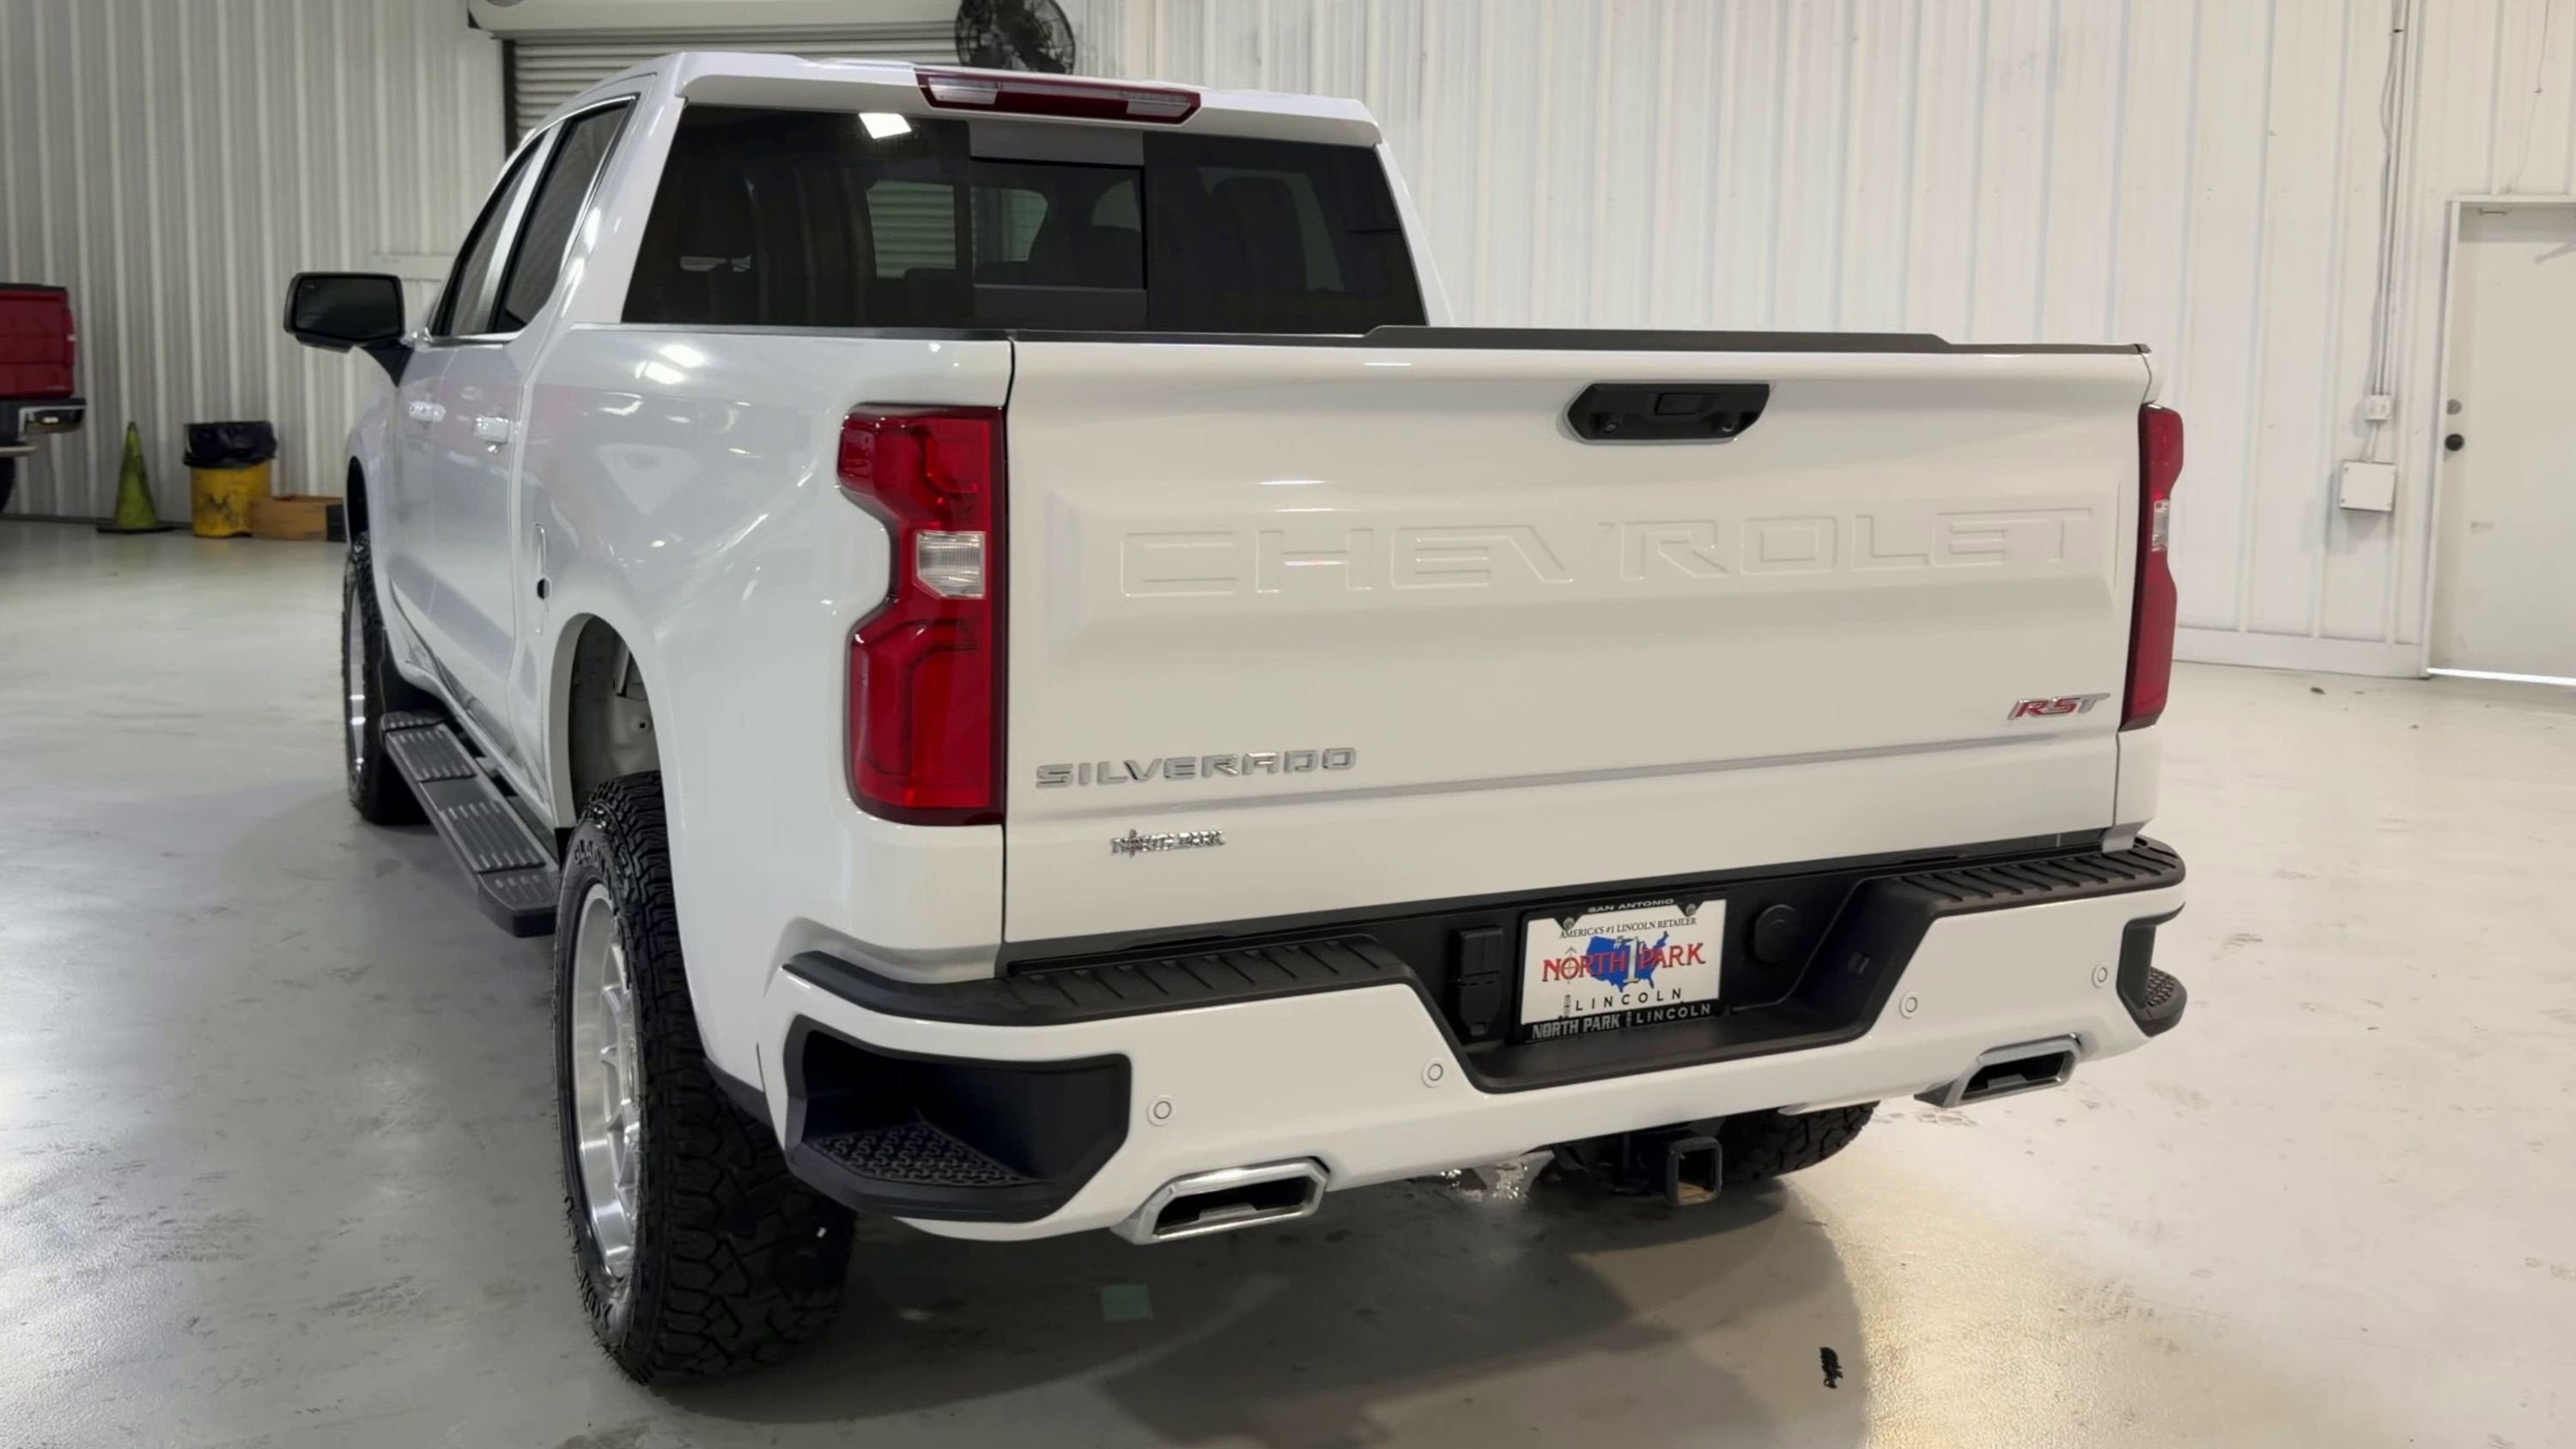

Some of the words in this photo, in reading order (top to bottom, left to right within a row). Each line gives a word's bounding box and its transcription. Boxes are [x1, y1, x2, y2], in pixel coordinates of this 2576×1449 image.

[1120, 507, 2093, 597] CHEVROLET
[2008, 692, 2111, 720] RST
[1036, 747, 1357, 789] SILVERADO
[1588, 904, 1614, 913] SAN
[1618, 898, 1674, 910] ANTONIO
[1559, 925, 1604, 939] AMERICA'S
[1606, 925, 1615, 934] #1
[1617, 920, 1656, 933] LINCOLN
[1657, 916, 1698, 928] RETAILER
[1541, 951, 1626, 983] NORTH
[1639, 943, 1707, 969] PARK
[1576, 988, 1682, 1011] LINCOLN
[1532, 1018, 1579, 1040] NORTH
[1583, 1014, 1621, 1033] PARK
[1637, 1003, 1711, 1024] LINCOLN
